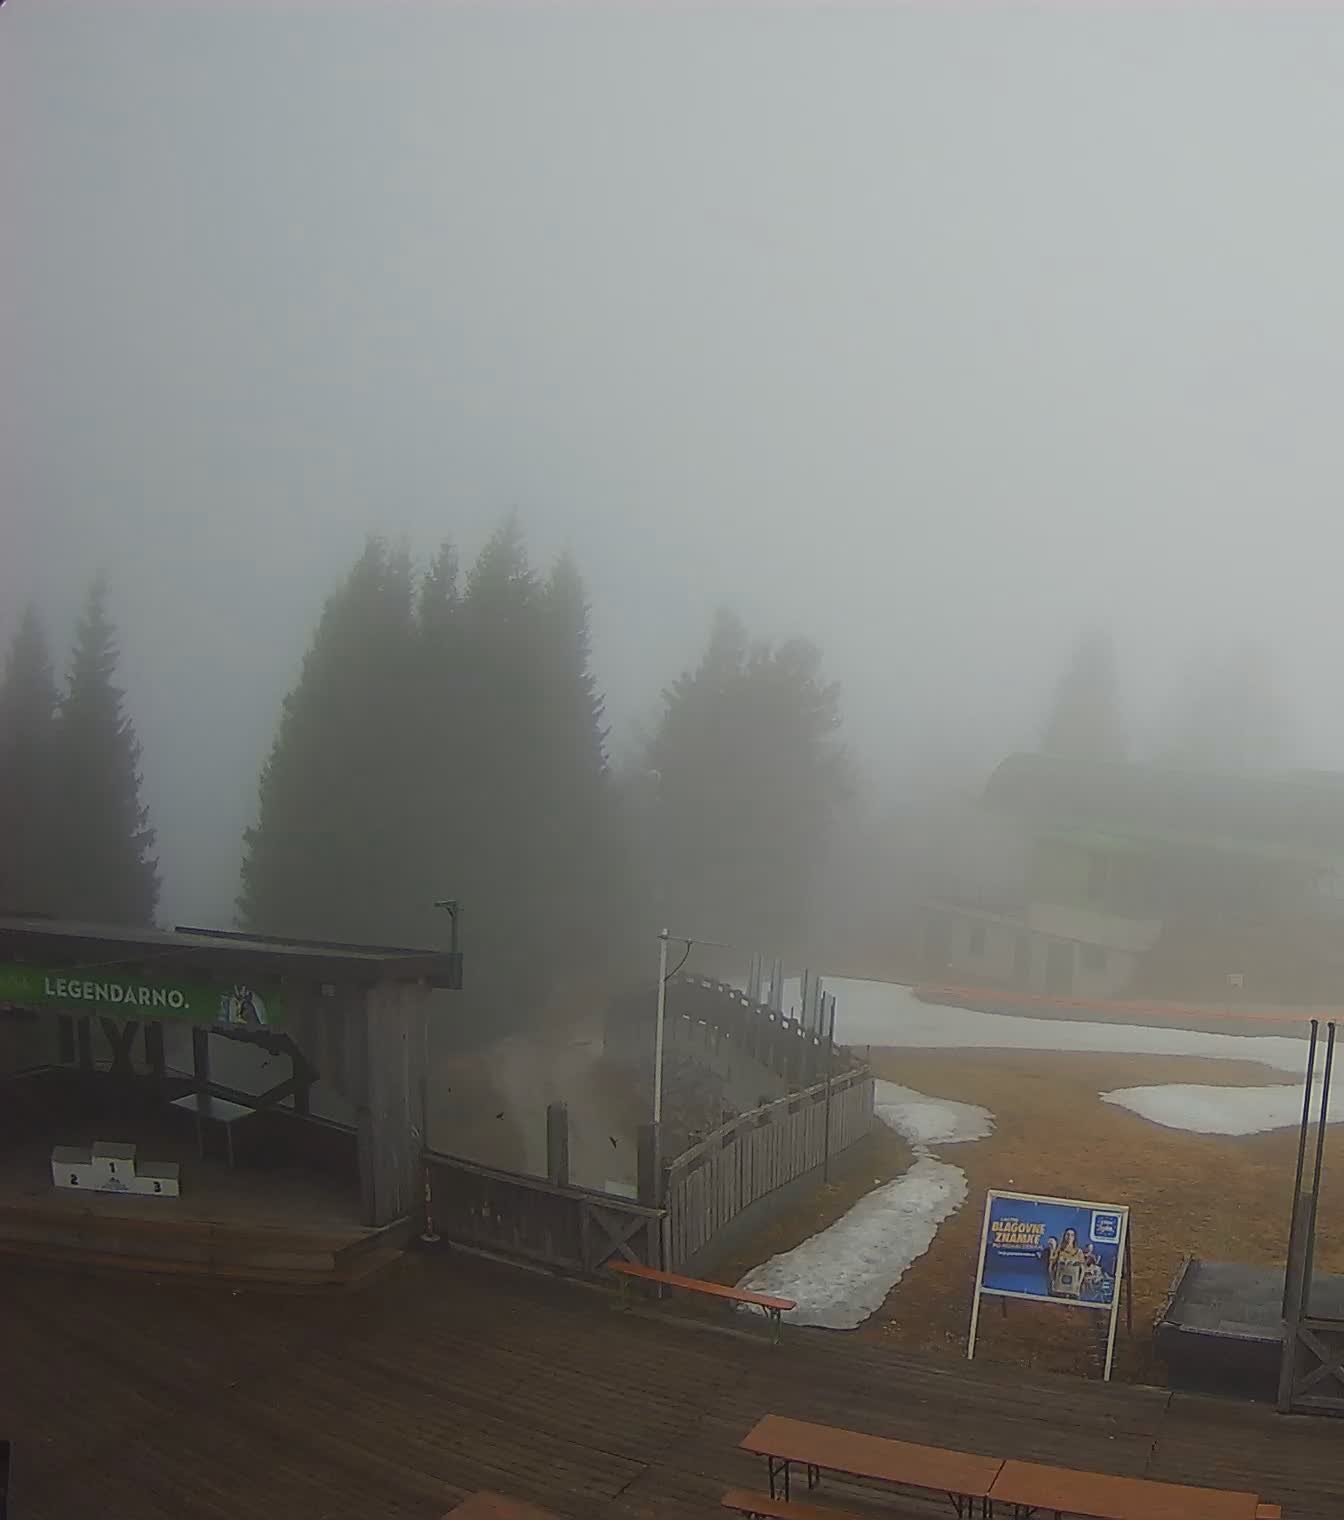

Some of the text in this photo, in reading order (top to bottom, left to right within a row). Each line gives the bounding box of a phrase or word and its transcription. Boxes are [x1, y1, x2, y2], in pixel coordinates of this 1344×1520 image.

[45, 977, 190, 1009] LEGENDARNO.
[109, 1162, 116, 1173] 1
[70, 1174, 78, 1185] 2
[153, 1181, 161, 1192] 3
[992, 1222, 1046, 1234] BLAGOVNE
[995, 1233, 1040, 1244] ZNAMKE
